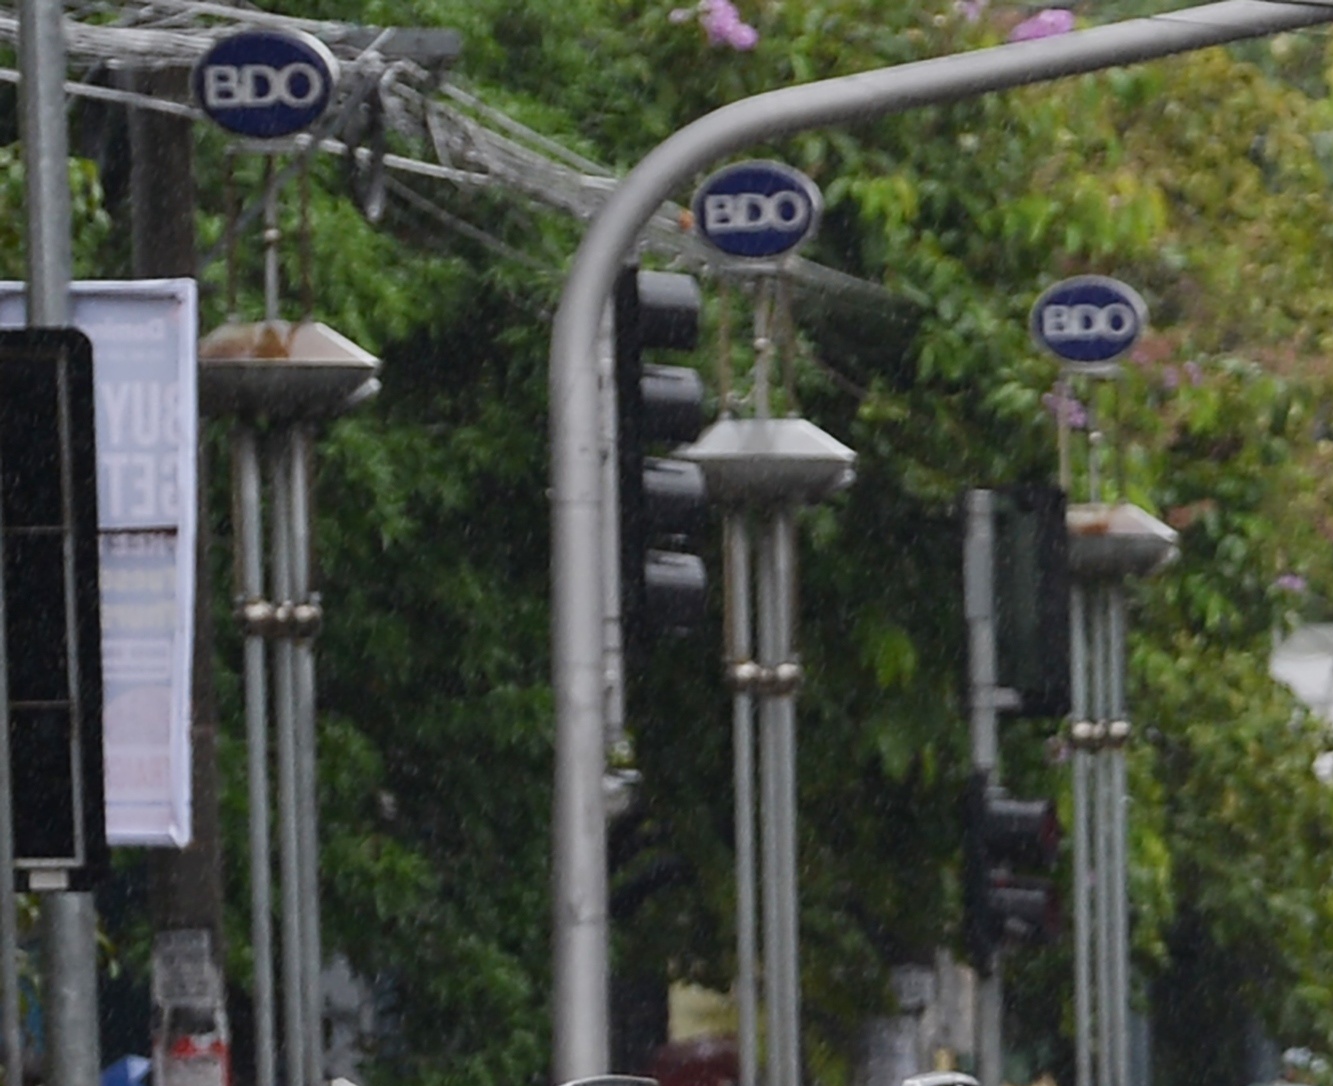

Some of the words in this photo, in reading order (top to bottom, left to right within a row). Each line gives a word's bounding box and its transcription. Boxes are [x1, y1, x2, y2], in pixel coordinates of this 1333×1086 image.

[204, 62, 322, 108] BDO
[704, 190, 810, 235] BDO
[1043, 302, 1136, 342] BDO
